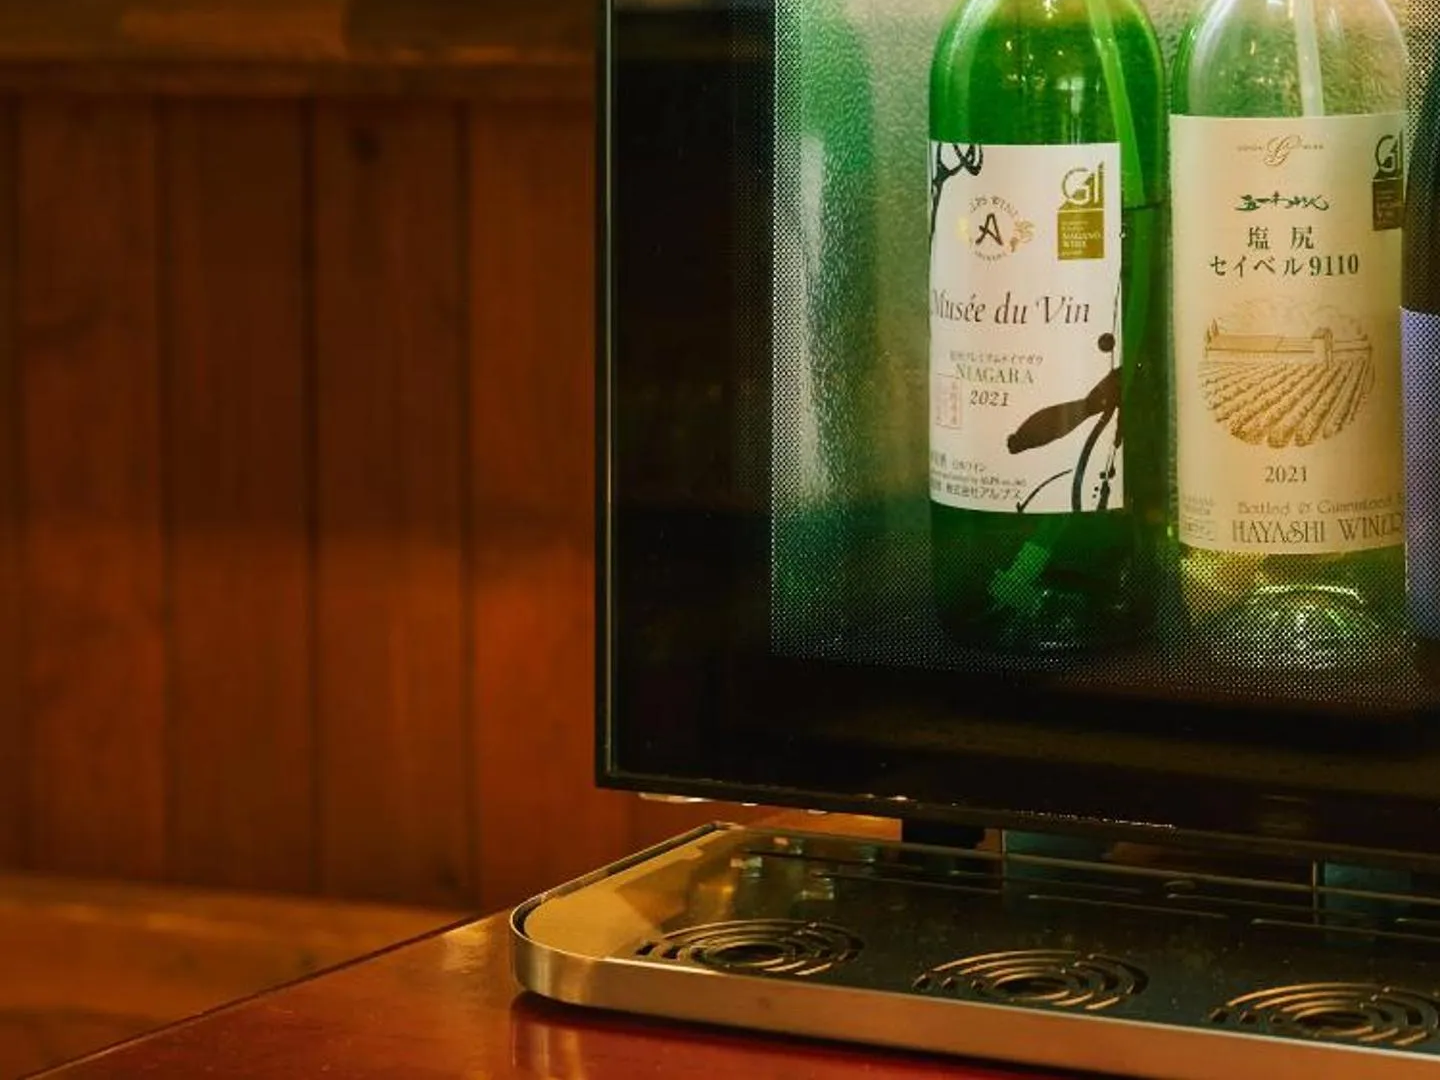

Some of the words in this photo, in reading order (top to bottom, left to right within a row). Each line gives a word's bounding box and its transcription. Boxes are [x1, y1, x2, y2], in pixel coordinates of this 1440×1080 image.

[1210, 253, 1360, 279] セイベル9110
[993, 291, 1027, 325] du
[1036, 295, 1091, 325] Vin
[956, 362, 1035, 384] NIAGARA
[969, 389, 1011, 407] 2021
[1264, 465, 1308, 484] 2021
[1231, 519, 1325, 544] HAYASHI
